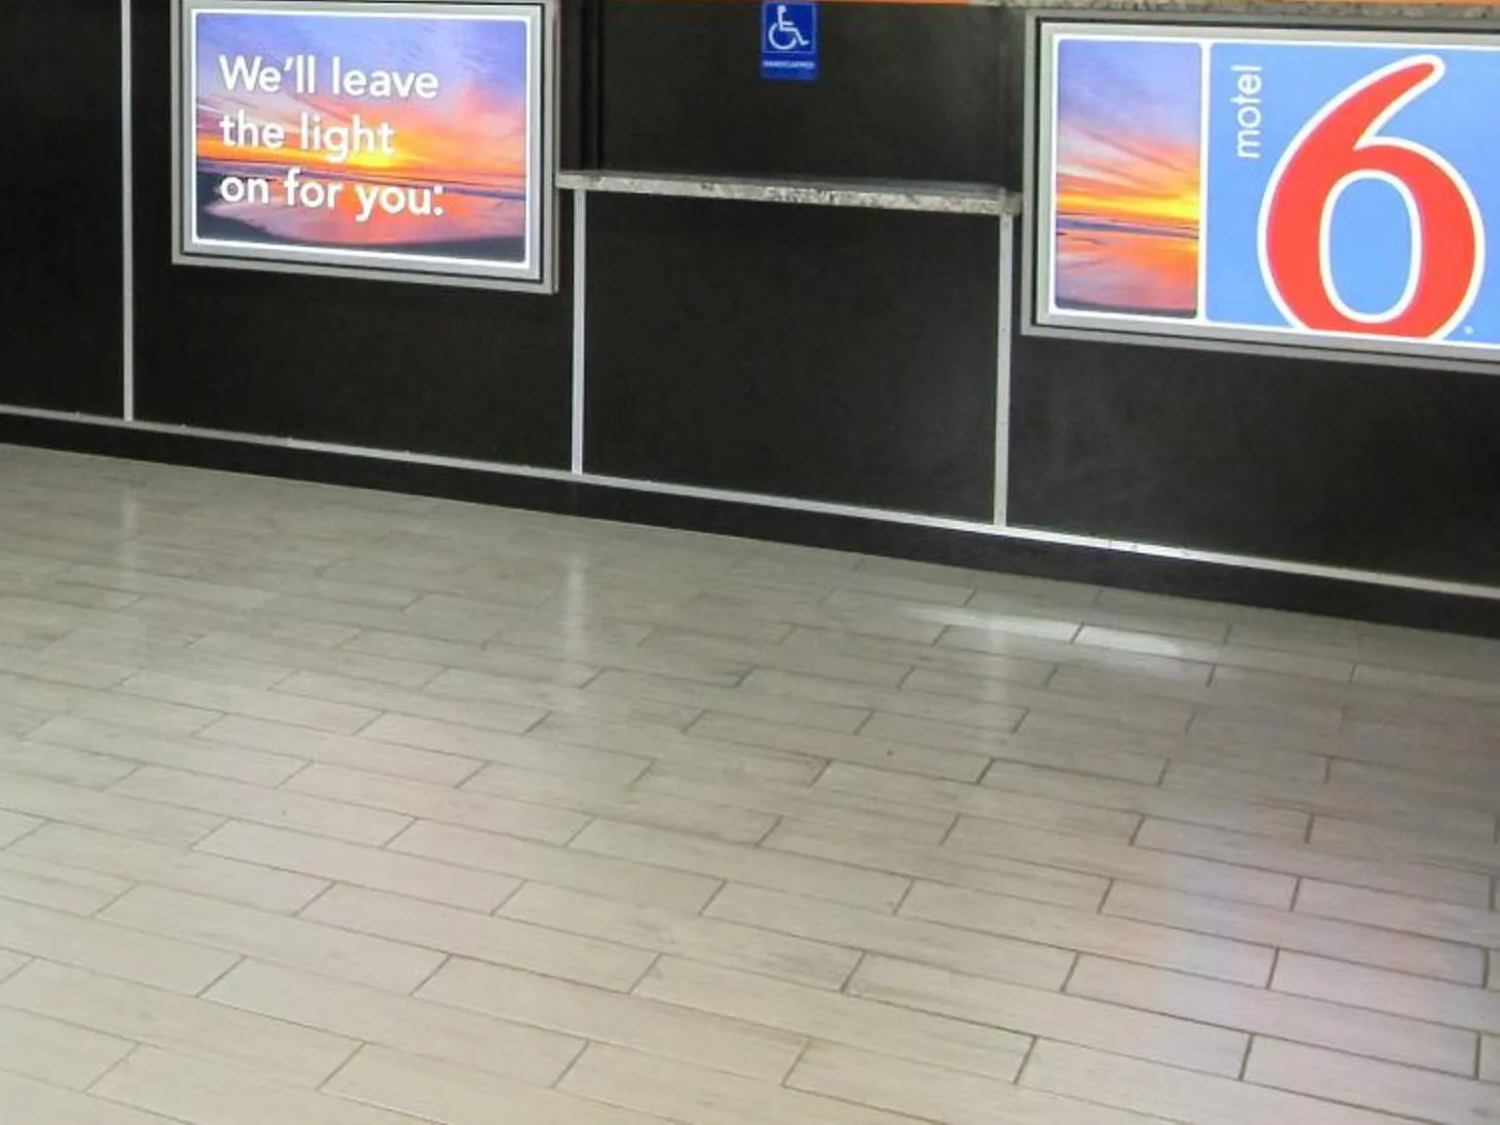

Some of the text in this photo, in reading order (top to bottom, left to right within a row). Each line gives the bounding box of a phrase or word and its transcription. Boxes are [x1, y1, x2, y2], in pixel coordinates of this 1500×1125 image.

[332, 56, 440, 99] leave
[219, 109, 395, 164] the light
[220, 176, 269, 204] on
[283, 168, 343, 209] for
[1230, 54, 1487, 342] motel 6
